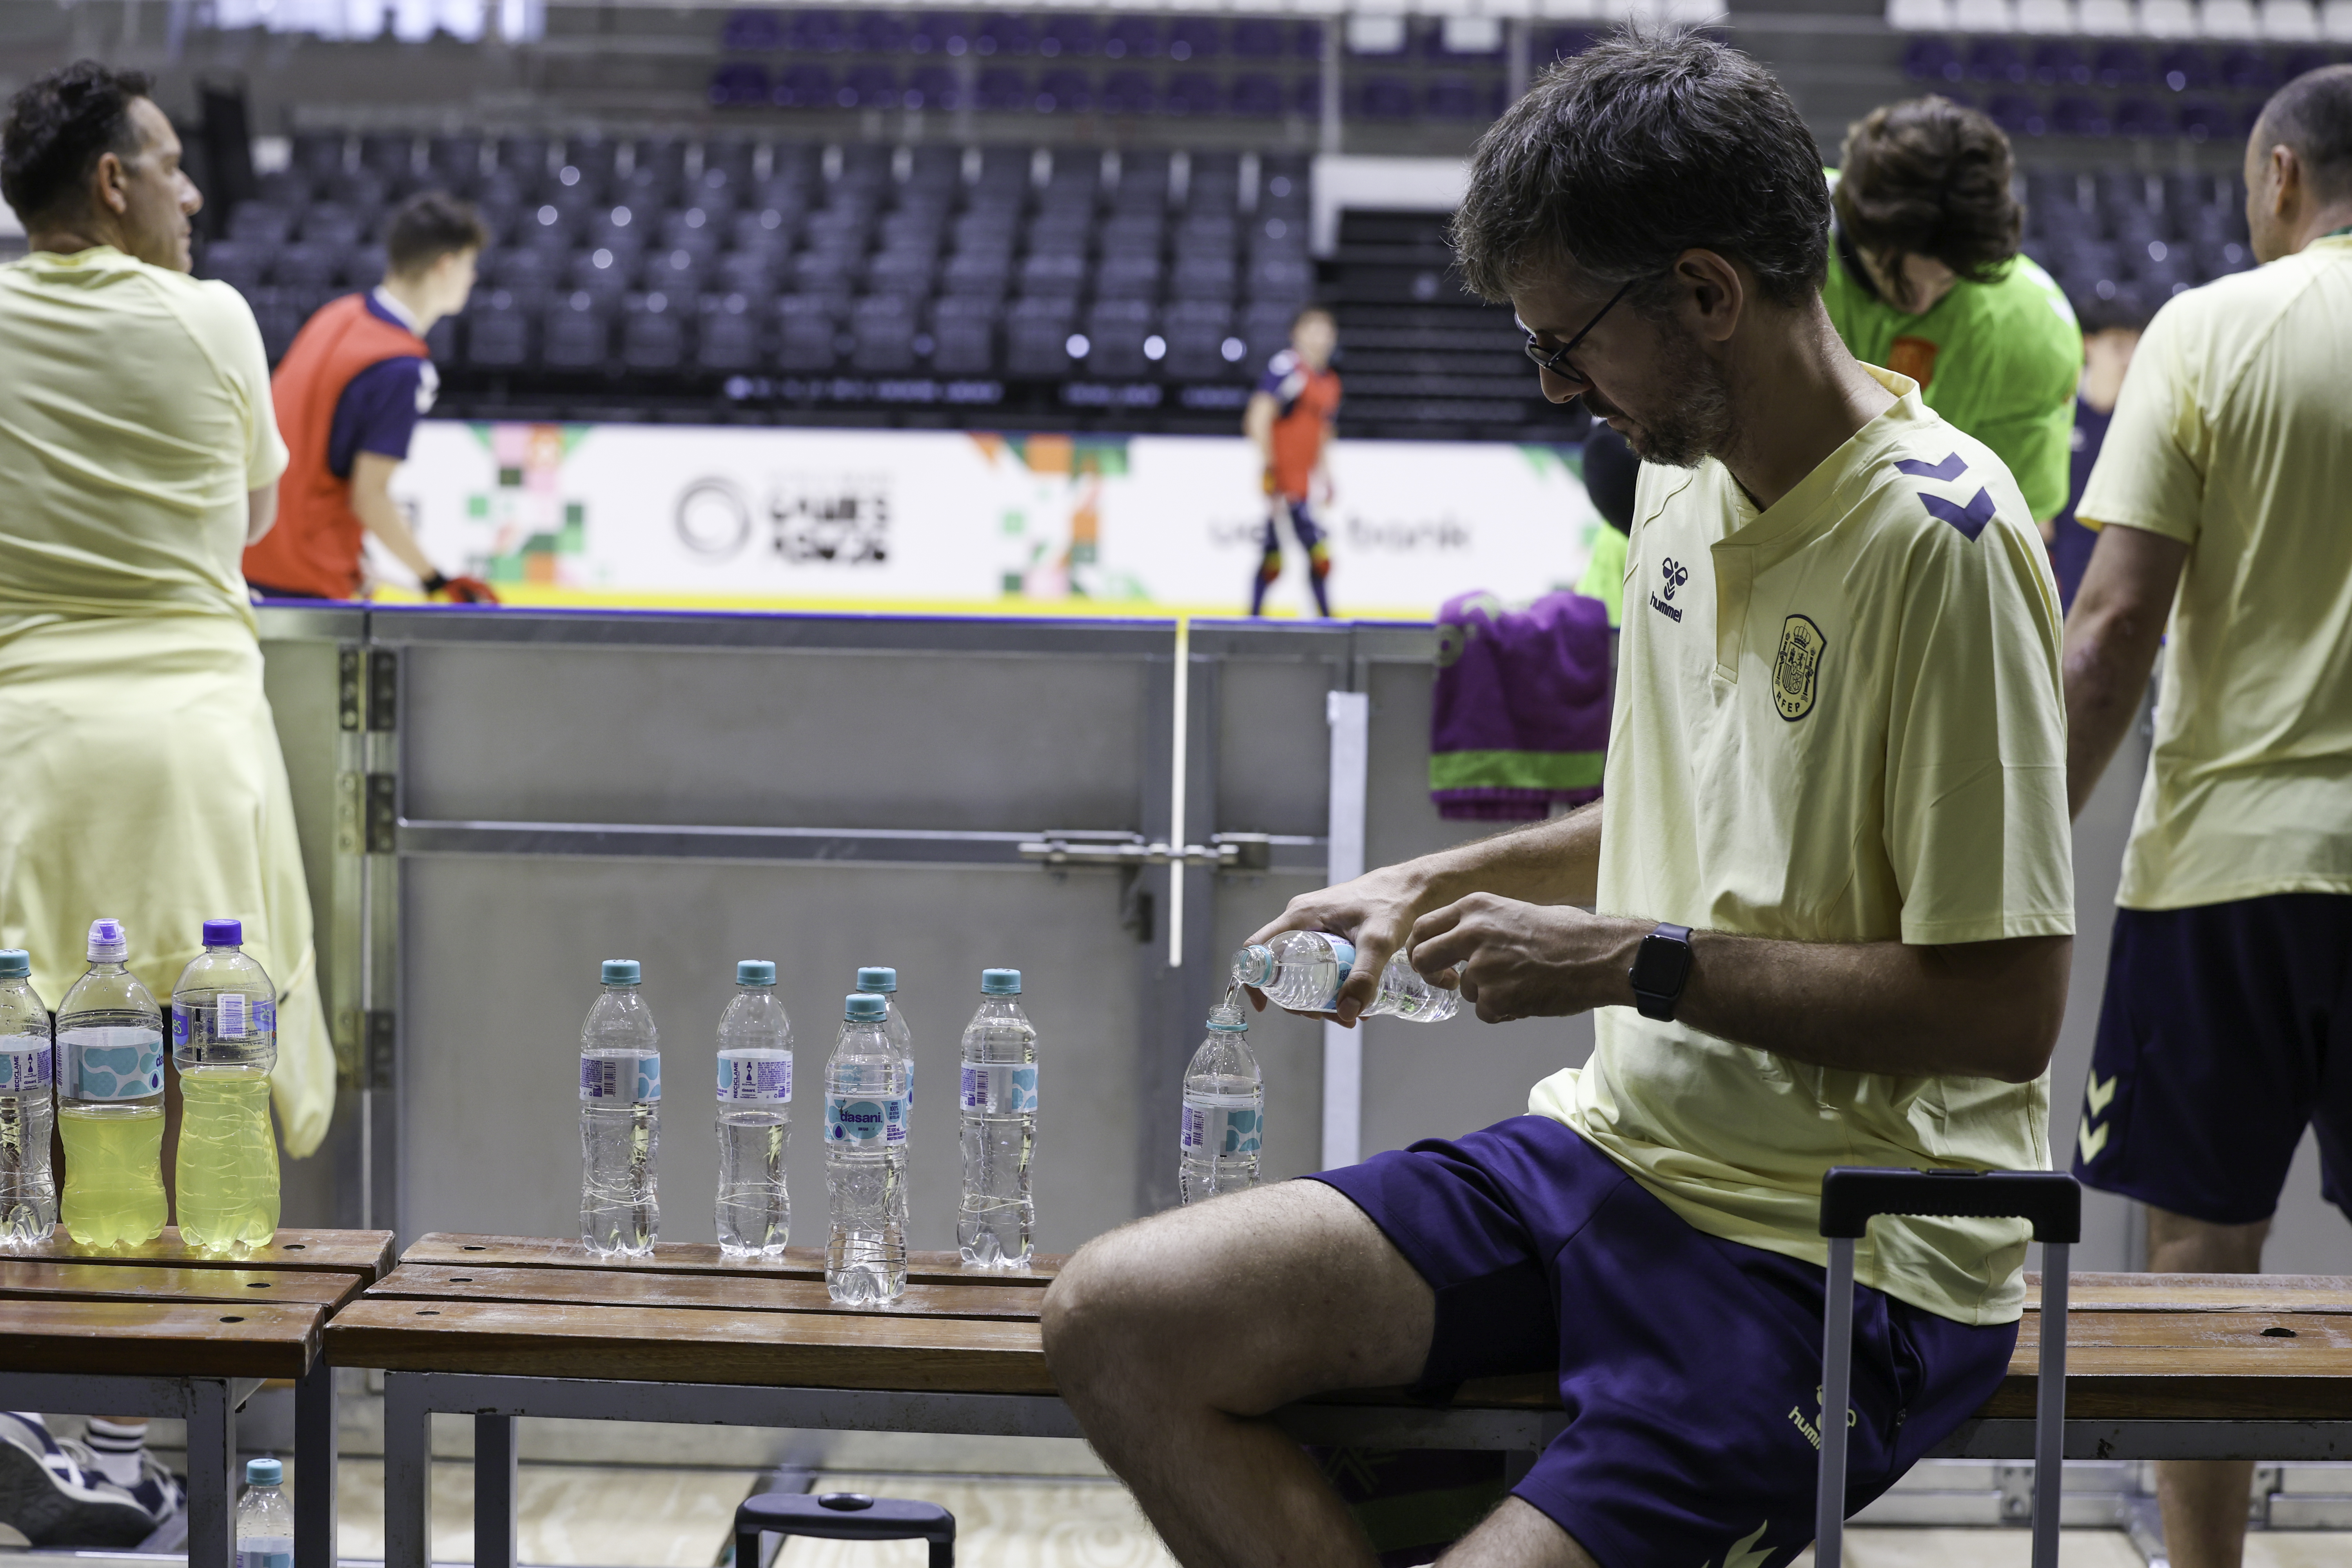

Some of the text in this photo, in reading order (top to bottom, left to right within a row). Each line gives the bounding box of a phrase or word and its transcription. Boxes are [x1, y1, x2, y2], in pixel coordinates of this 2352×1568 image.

[1650, 591, 1682, 623] hummel
[1776, 691, 1801, 713] RFEP
[1788, 1406, 1820, 1450] hum
